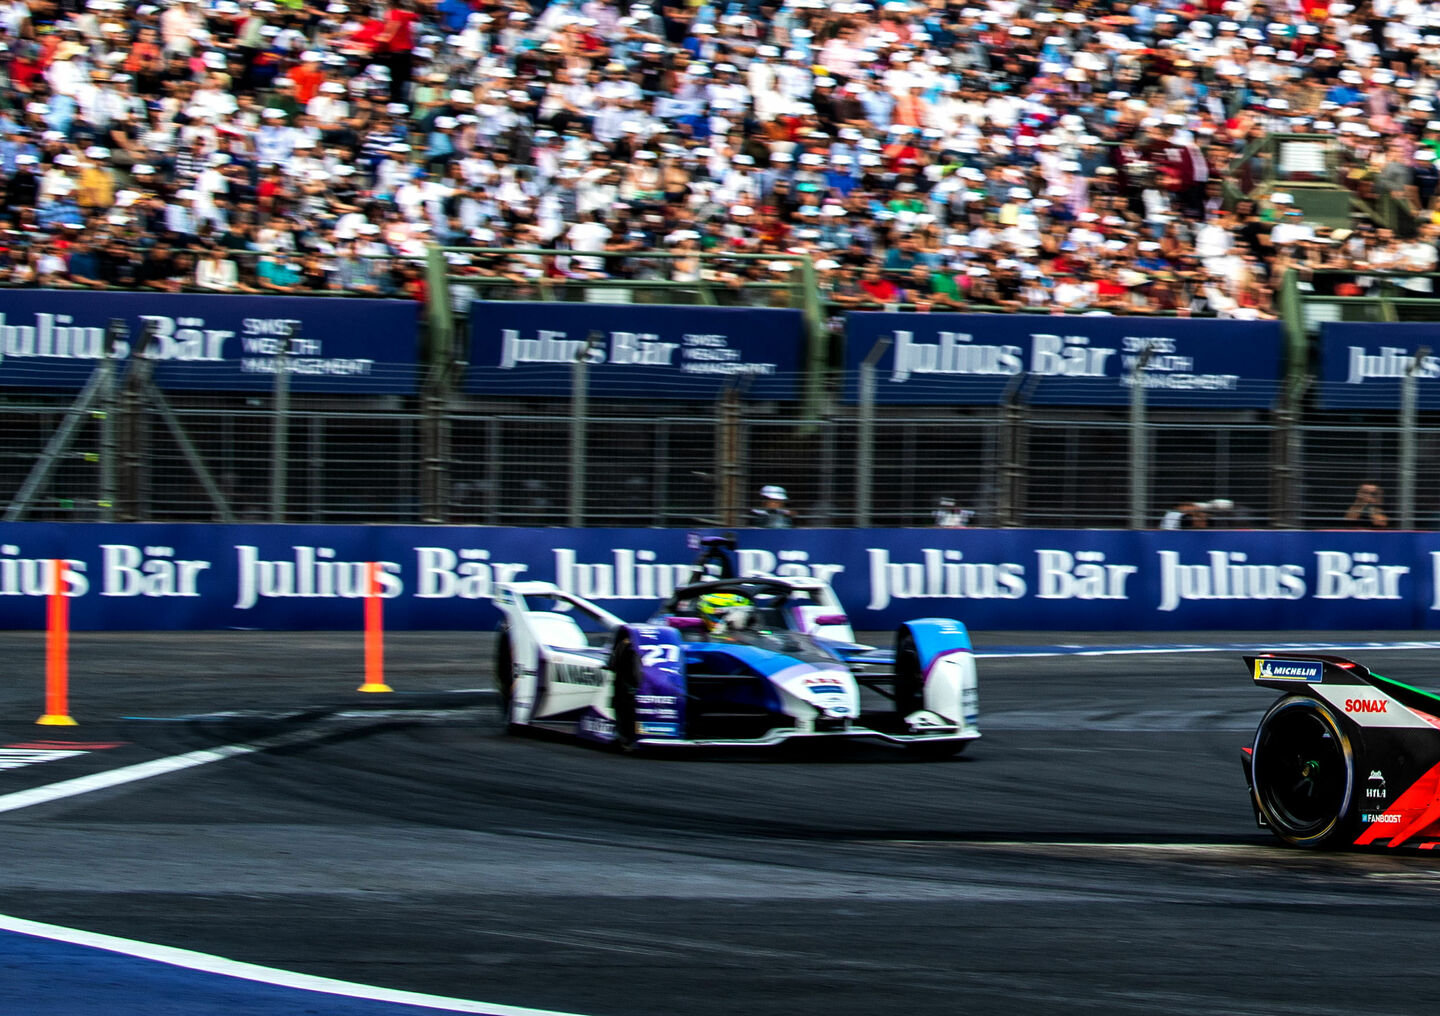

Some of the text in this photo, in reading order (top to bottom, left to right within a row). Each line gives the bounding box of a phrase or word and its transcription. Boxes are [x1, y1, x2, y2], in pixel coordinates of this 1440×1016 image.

[0, 313, 236, 363] ulius Bär
[499, 329, 679, 369] Julius Bär
[891, 330, 1116, 382] Julius Bär
[99, 545, 211, 597] Bär
[233, 545, 528, 609] Julius Bär
[866, 548, 1138, 610] Julius Bär
[1156, 550, 1410, 611] Julius Bär
[638, 644, 680, 668] 27
[1273, 666, 1317, 677] MICHELIN
[1345, 699, 1387, 713] SONAX
